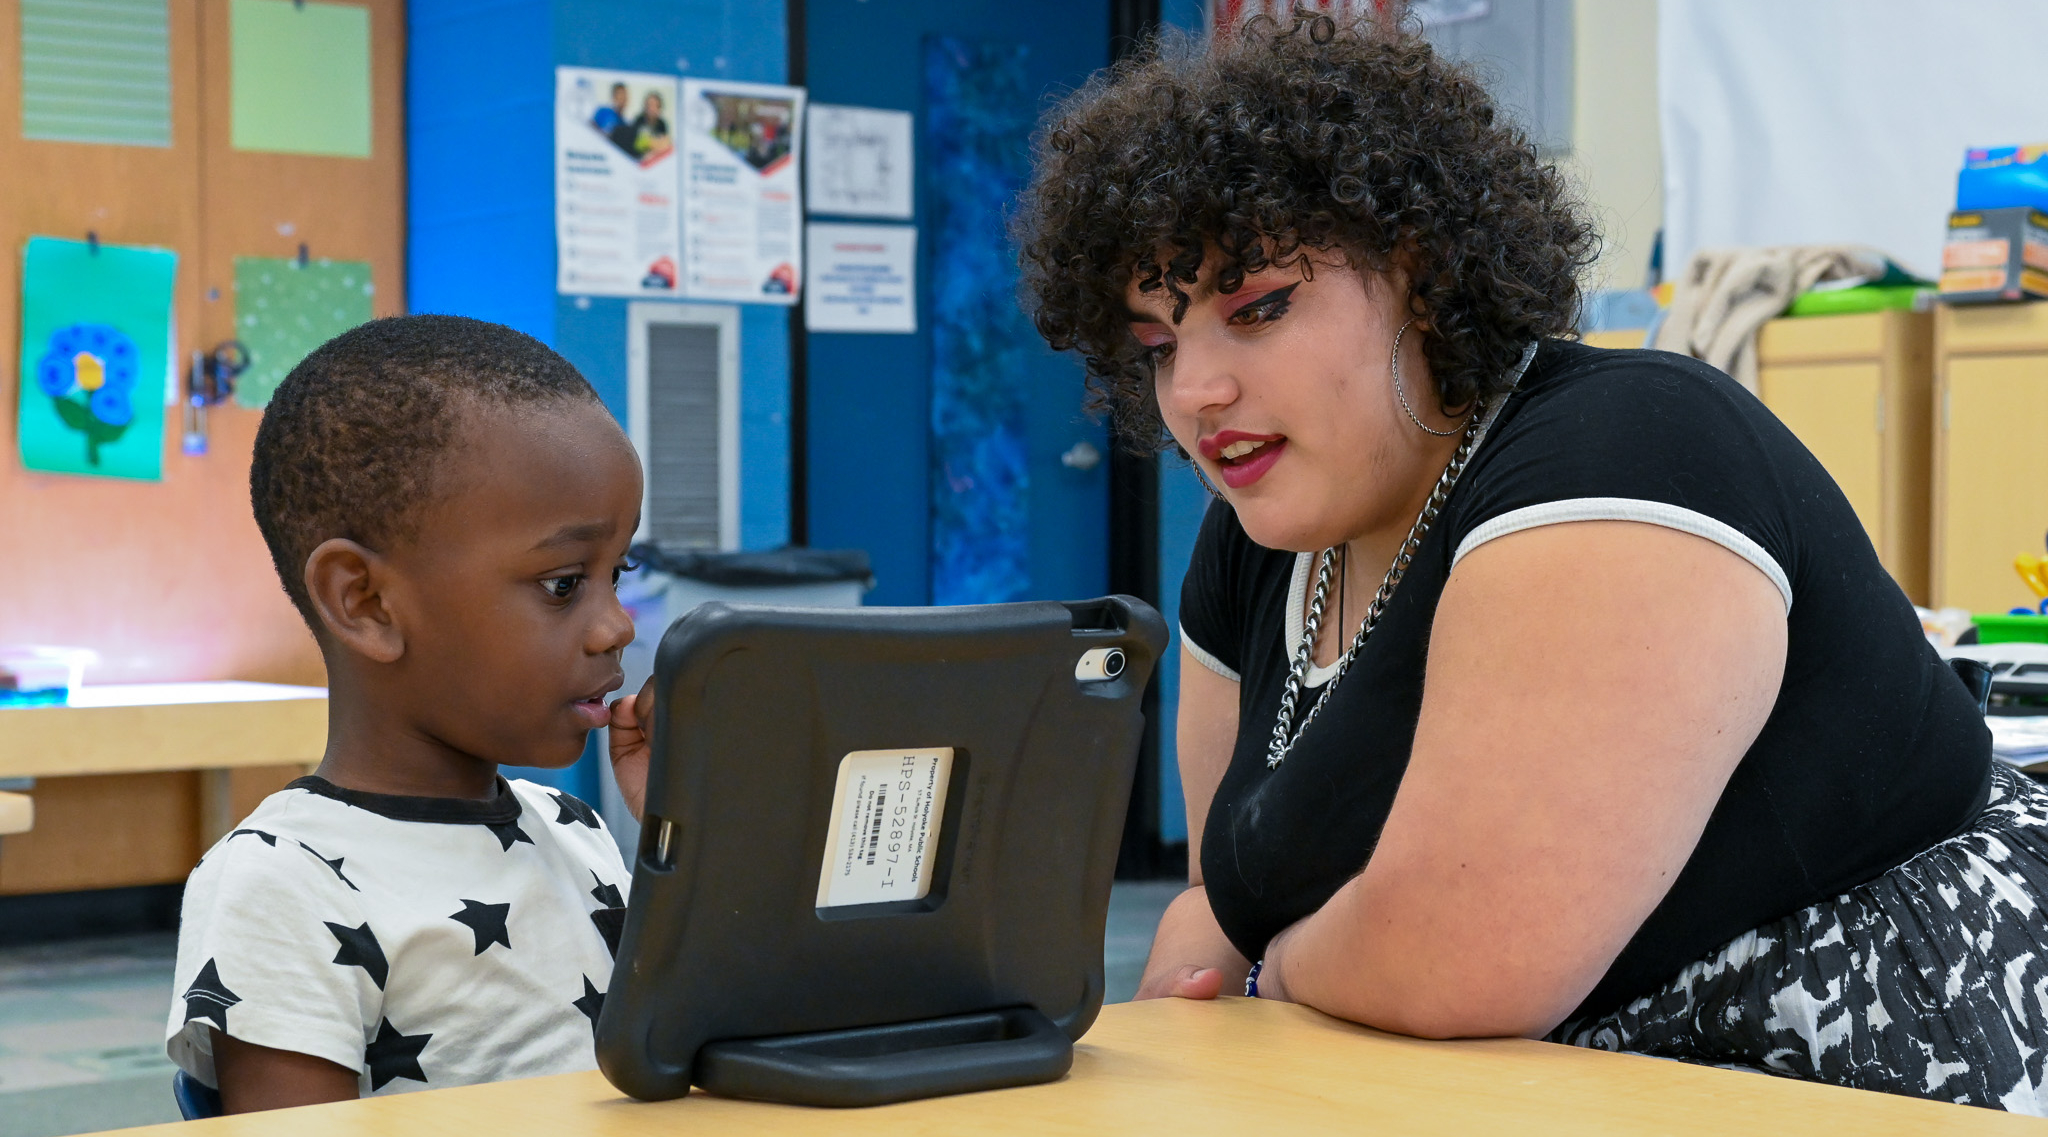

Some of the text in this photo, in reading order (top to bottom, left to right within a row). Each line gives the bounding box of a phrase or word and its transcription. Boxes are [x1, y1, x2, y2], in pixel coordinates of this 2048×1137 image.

[927, 758, 938, 789] Property
[858, 780, 866, 799] found
[881, 755, 916, 888] HPS-52897-I
[919, 801, 931, 830] Holyoke
[917, 832, 925, 853] Public
[911, 855, 921, 882] Schools
